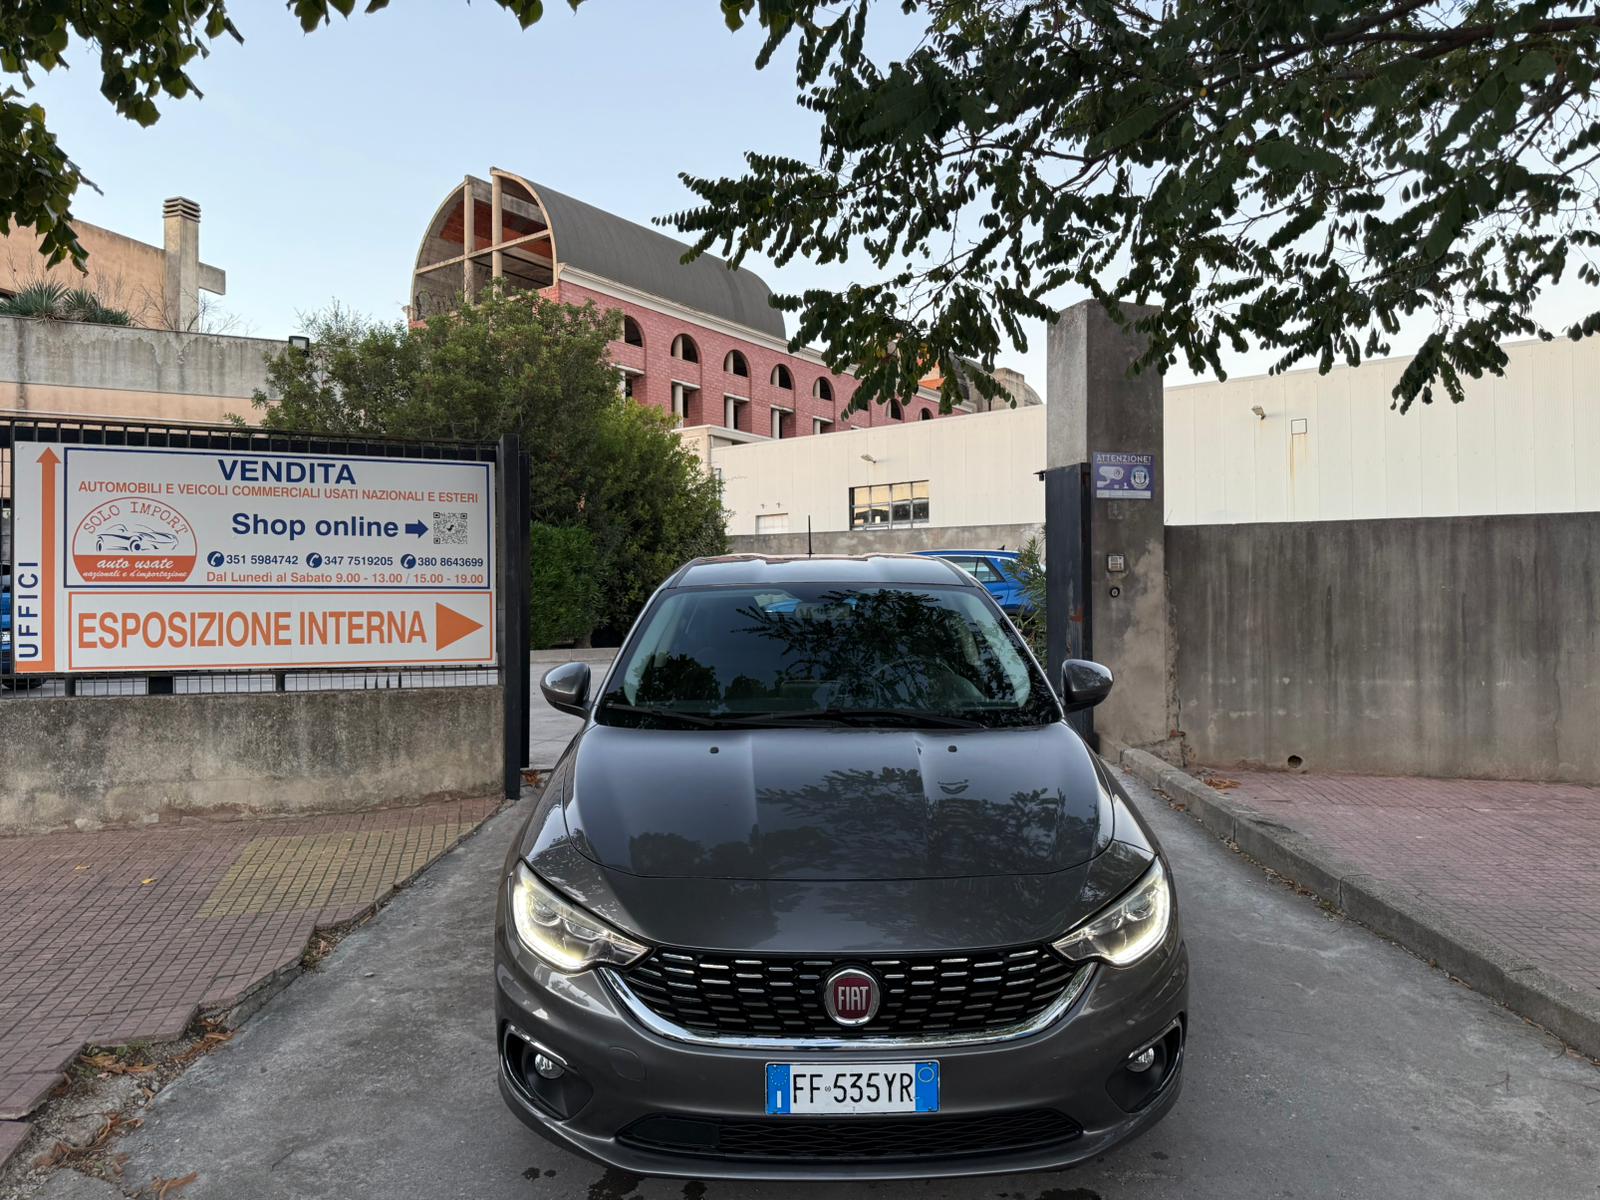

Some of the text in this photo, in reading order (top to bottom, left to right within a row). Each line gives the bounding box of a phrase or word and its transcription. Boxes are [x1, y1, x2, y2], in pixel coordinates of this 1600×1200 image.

[218, 459, 356, 485] VENDITA
[78, 480, 479, 503] AUTOMOBILI E VEICOLI COMMERCIALI USATI NAZIONALI E ESTERI
[83, 501, 189, 535] SOLO IMPORT
[232, 512, 399, 541] Shop online
[96, 558, 174, 569] auto usate
[226, 554, 298, 565] 351 5984742
[324, 555, 393, 566] 347 7519205
[417, 557, 484, 567] 380 8643699
[83, 570, 121, 579] nazionali
[206, 571, 227, 582] Dal
[231, 571, 272, 582] Lunedì
[276, 572, 287, 583] al
[290, 572, 333, 583] Sabato
[335, 572, 361, 583] 9.00
[372, 573, 403, 583] 13.00
[413, 573, 443, 583] 15.00
[454, 573, 484, 584] 19.00
[18, 562, 39, 658] UFFICI
[78, 610, 427, 649] ESPOSIZIONE INTERNA
[838, 986, 869, 1011] FIAT
[793, 1073, 914, 1103] FF 535YR
